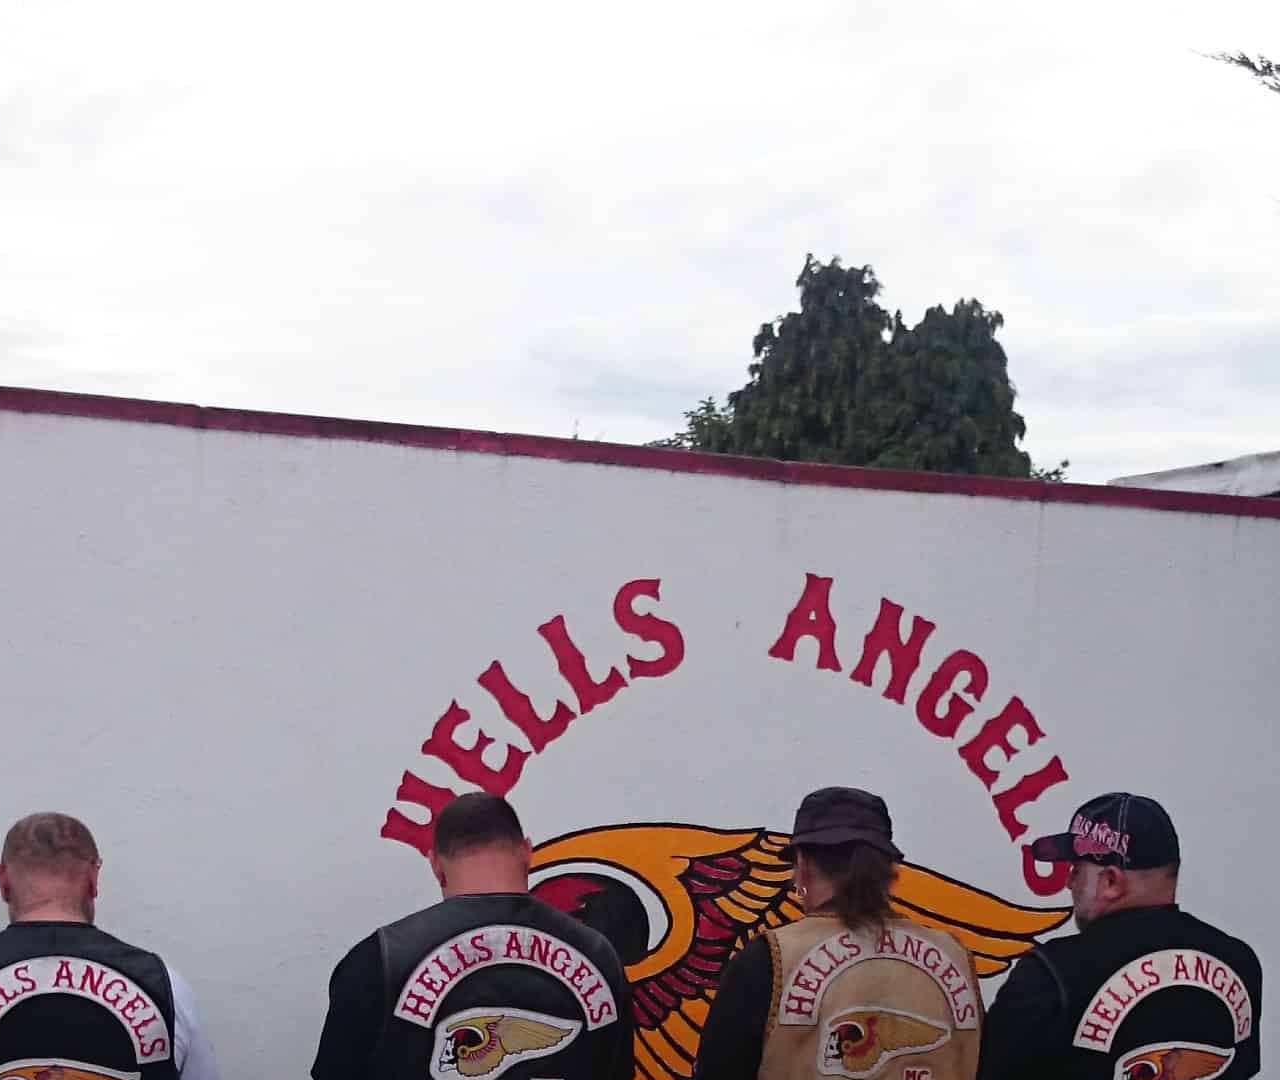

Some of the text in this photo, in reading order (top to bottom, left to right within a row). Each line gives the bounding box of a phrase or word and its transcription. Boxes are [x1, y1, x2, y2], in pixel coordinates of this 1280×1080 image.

[380, 577, 686, 858] HELLS
[52, 960, 167, 1058] ANGELS
[401, 931, 613, 1024] HELLS ANGELS
[785, 930, 975, 1024] HELLS ANGELS
[1080, 954, 1250, 1046] HELLS ANGELS
